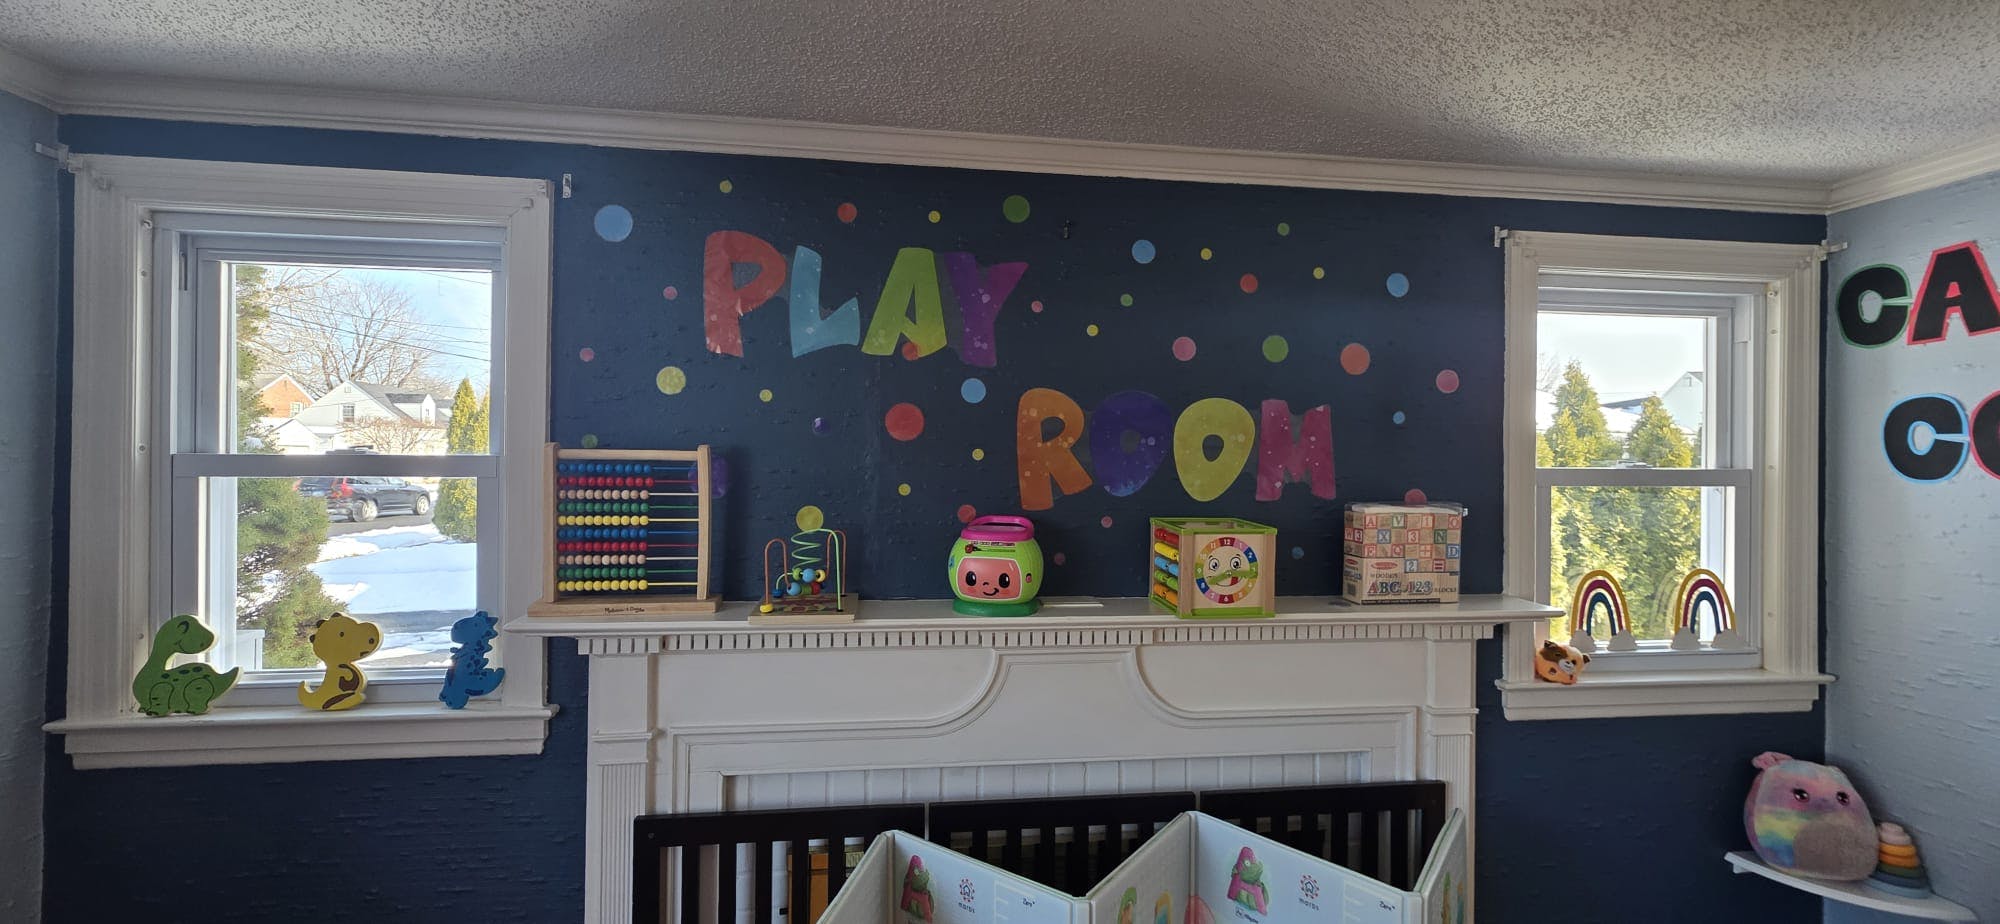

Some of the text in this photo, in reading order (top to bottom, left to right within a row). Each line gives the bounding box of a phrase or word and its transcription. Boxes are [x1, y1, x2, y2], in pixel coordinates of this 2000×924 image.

[703, 230, 1029, 367] PLAY
[1017, 387, 1336, 511] ROOM
[1366, 581, 1401, 595] ABC
[1406, 580, 1433, 595] 123
